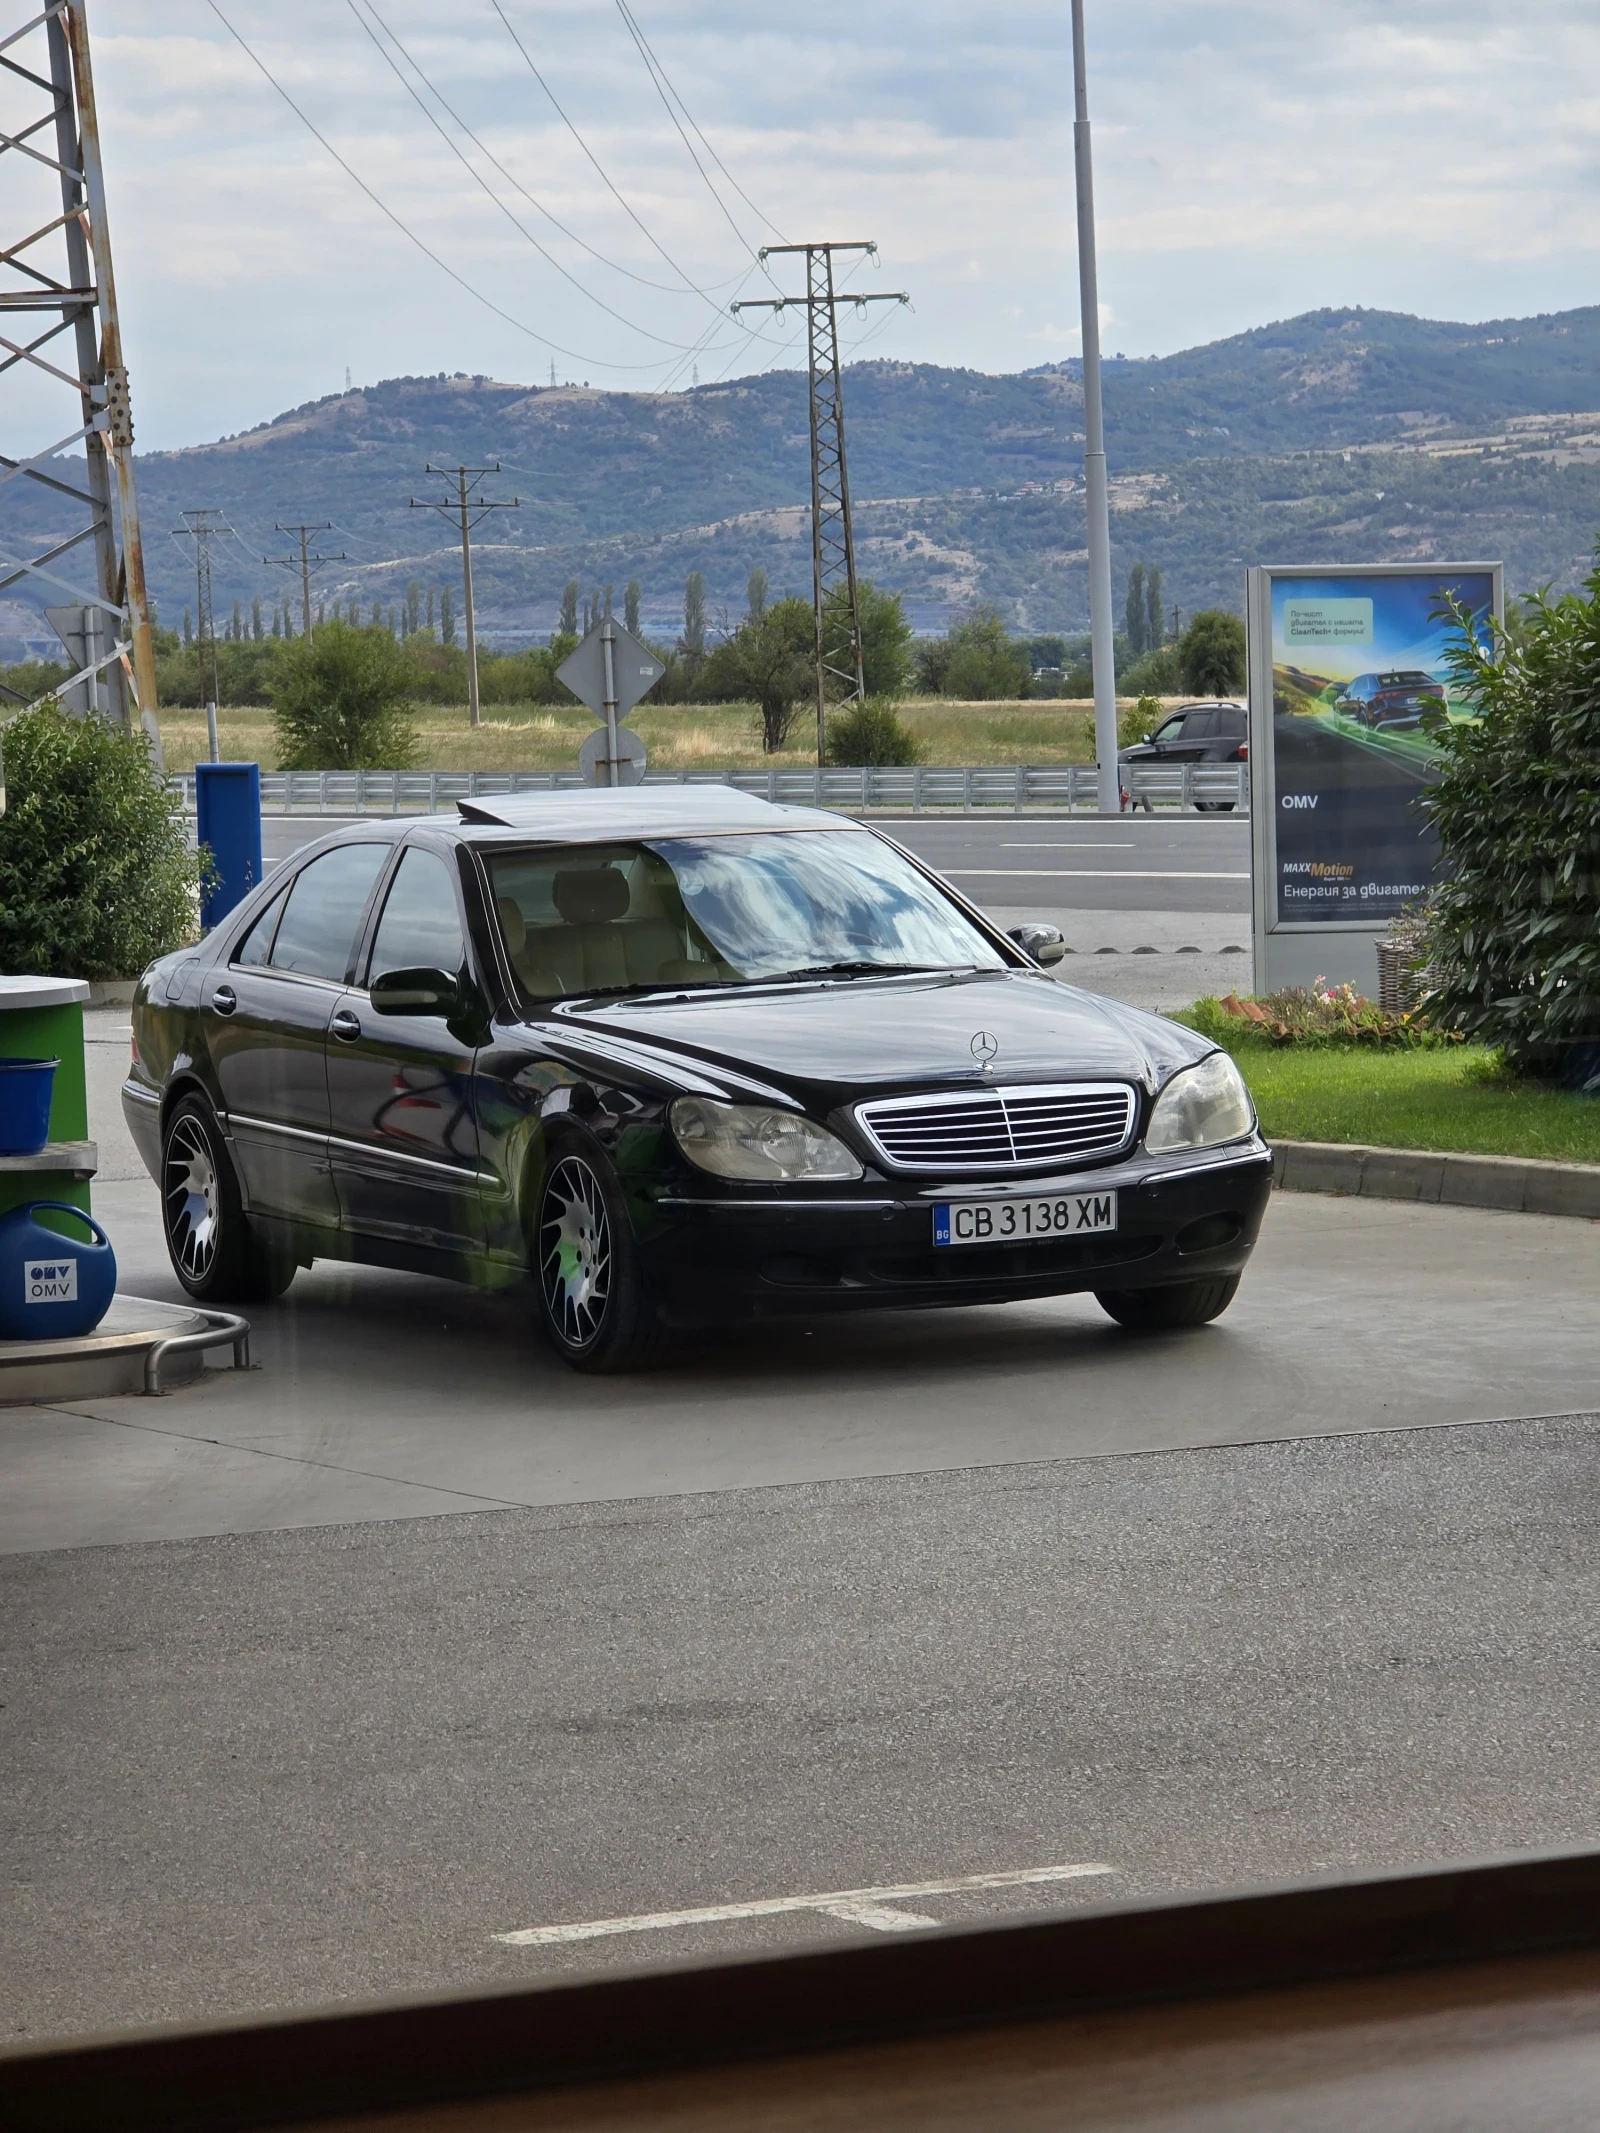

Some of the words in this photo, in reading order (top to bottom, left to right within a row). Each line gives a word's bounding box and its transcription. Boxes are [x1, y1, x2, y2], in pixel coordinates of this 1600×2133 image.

[1290, 610, 1323, 618] По-чист
[1290, 618, 1327, 627] двигател
[1290, 627, 1332, 636] CleanTech+
[1281, 794, 1319, 809] OMV
[1284, 884, 1339, 899] Енергия
[1342, 885, 1357, 899] за
[955, 1206, 993, 1239] CB
[999, 1200, 1069, 1236] 3138
[1075, 1195, 1111, 1229] XM
[936, 1230, 949, 1240] BG
[31, 1283, 70, 1297] OMV
